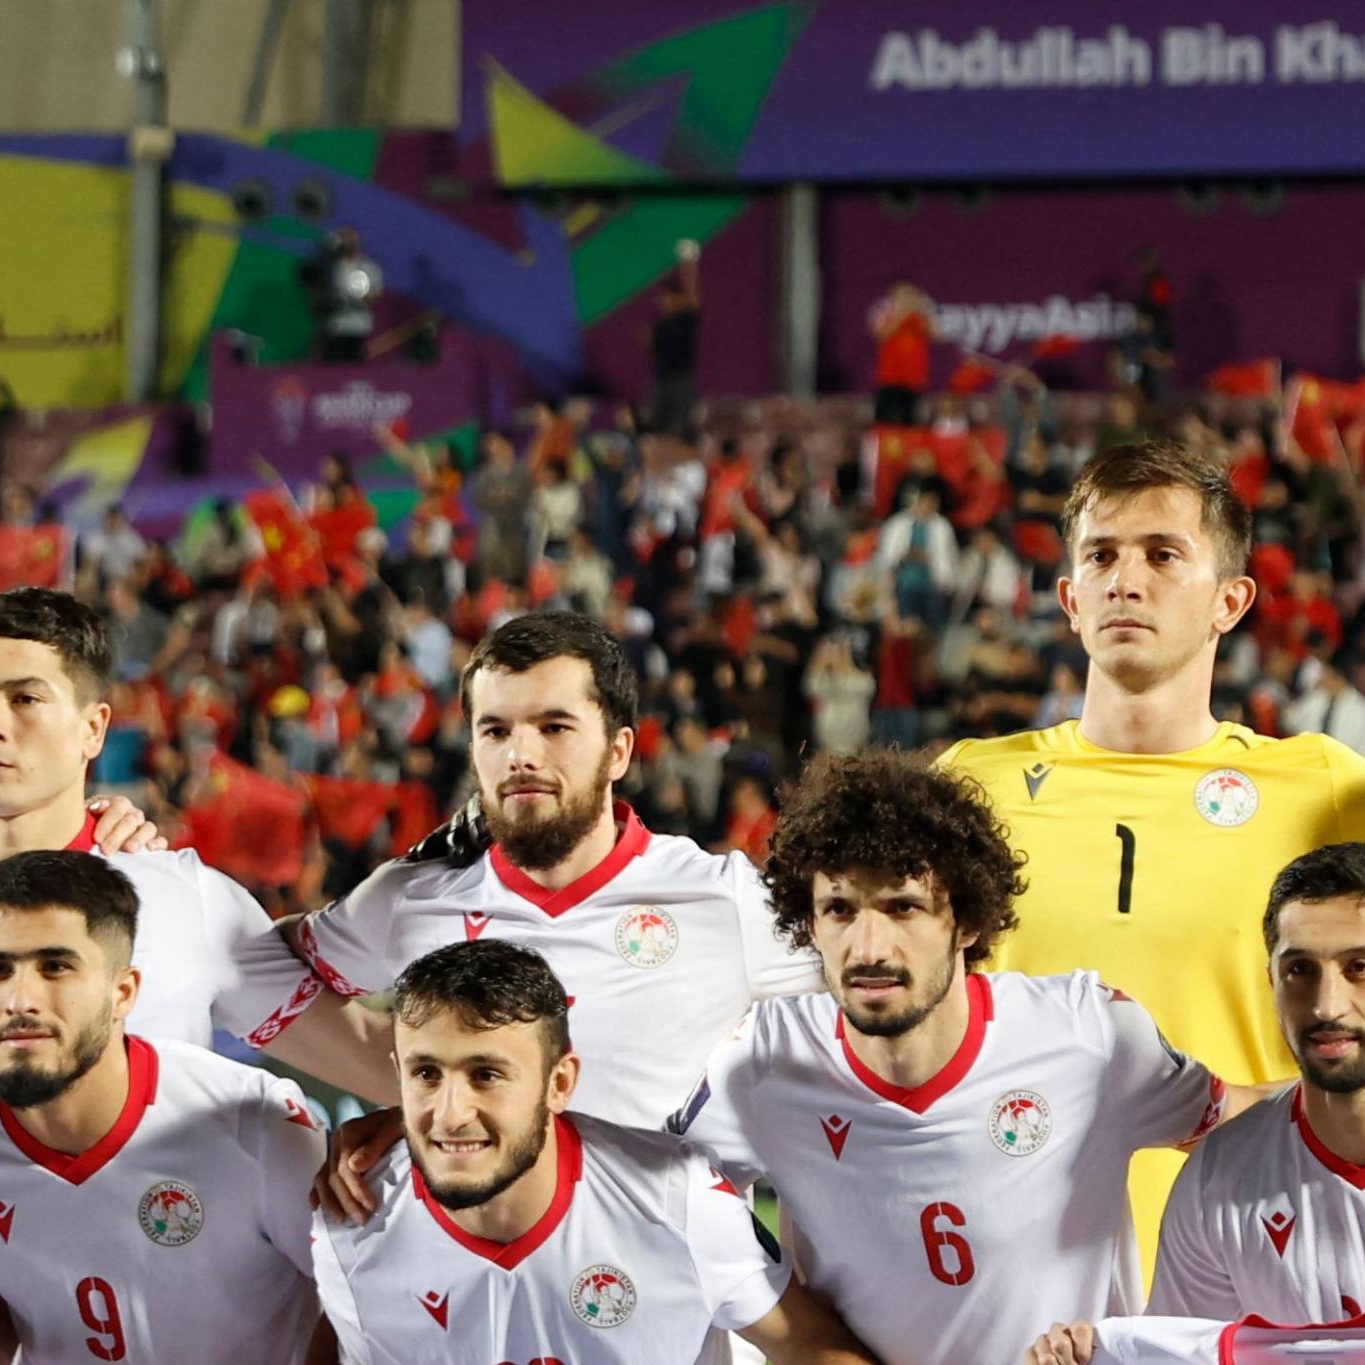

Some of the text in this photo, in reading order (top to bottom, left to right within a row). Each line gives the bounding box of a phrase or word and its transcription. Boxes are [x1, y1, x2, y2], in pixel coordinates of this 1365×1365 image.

[871, 24, 1152, 92] Abdullah
[1161, 21, 1265, 85] Bin
[1115, 822, 1136, 914] 1
[920, 1201, 976, 1287] 6
[75, 1276, 126, 1362] 9
